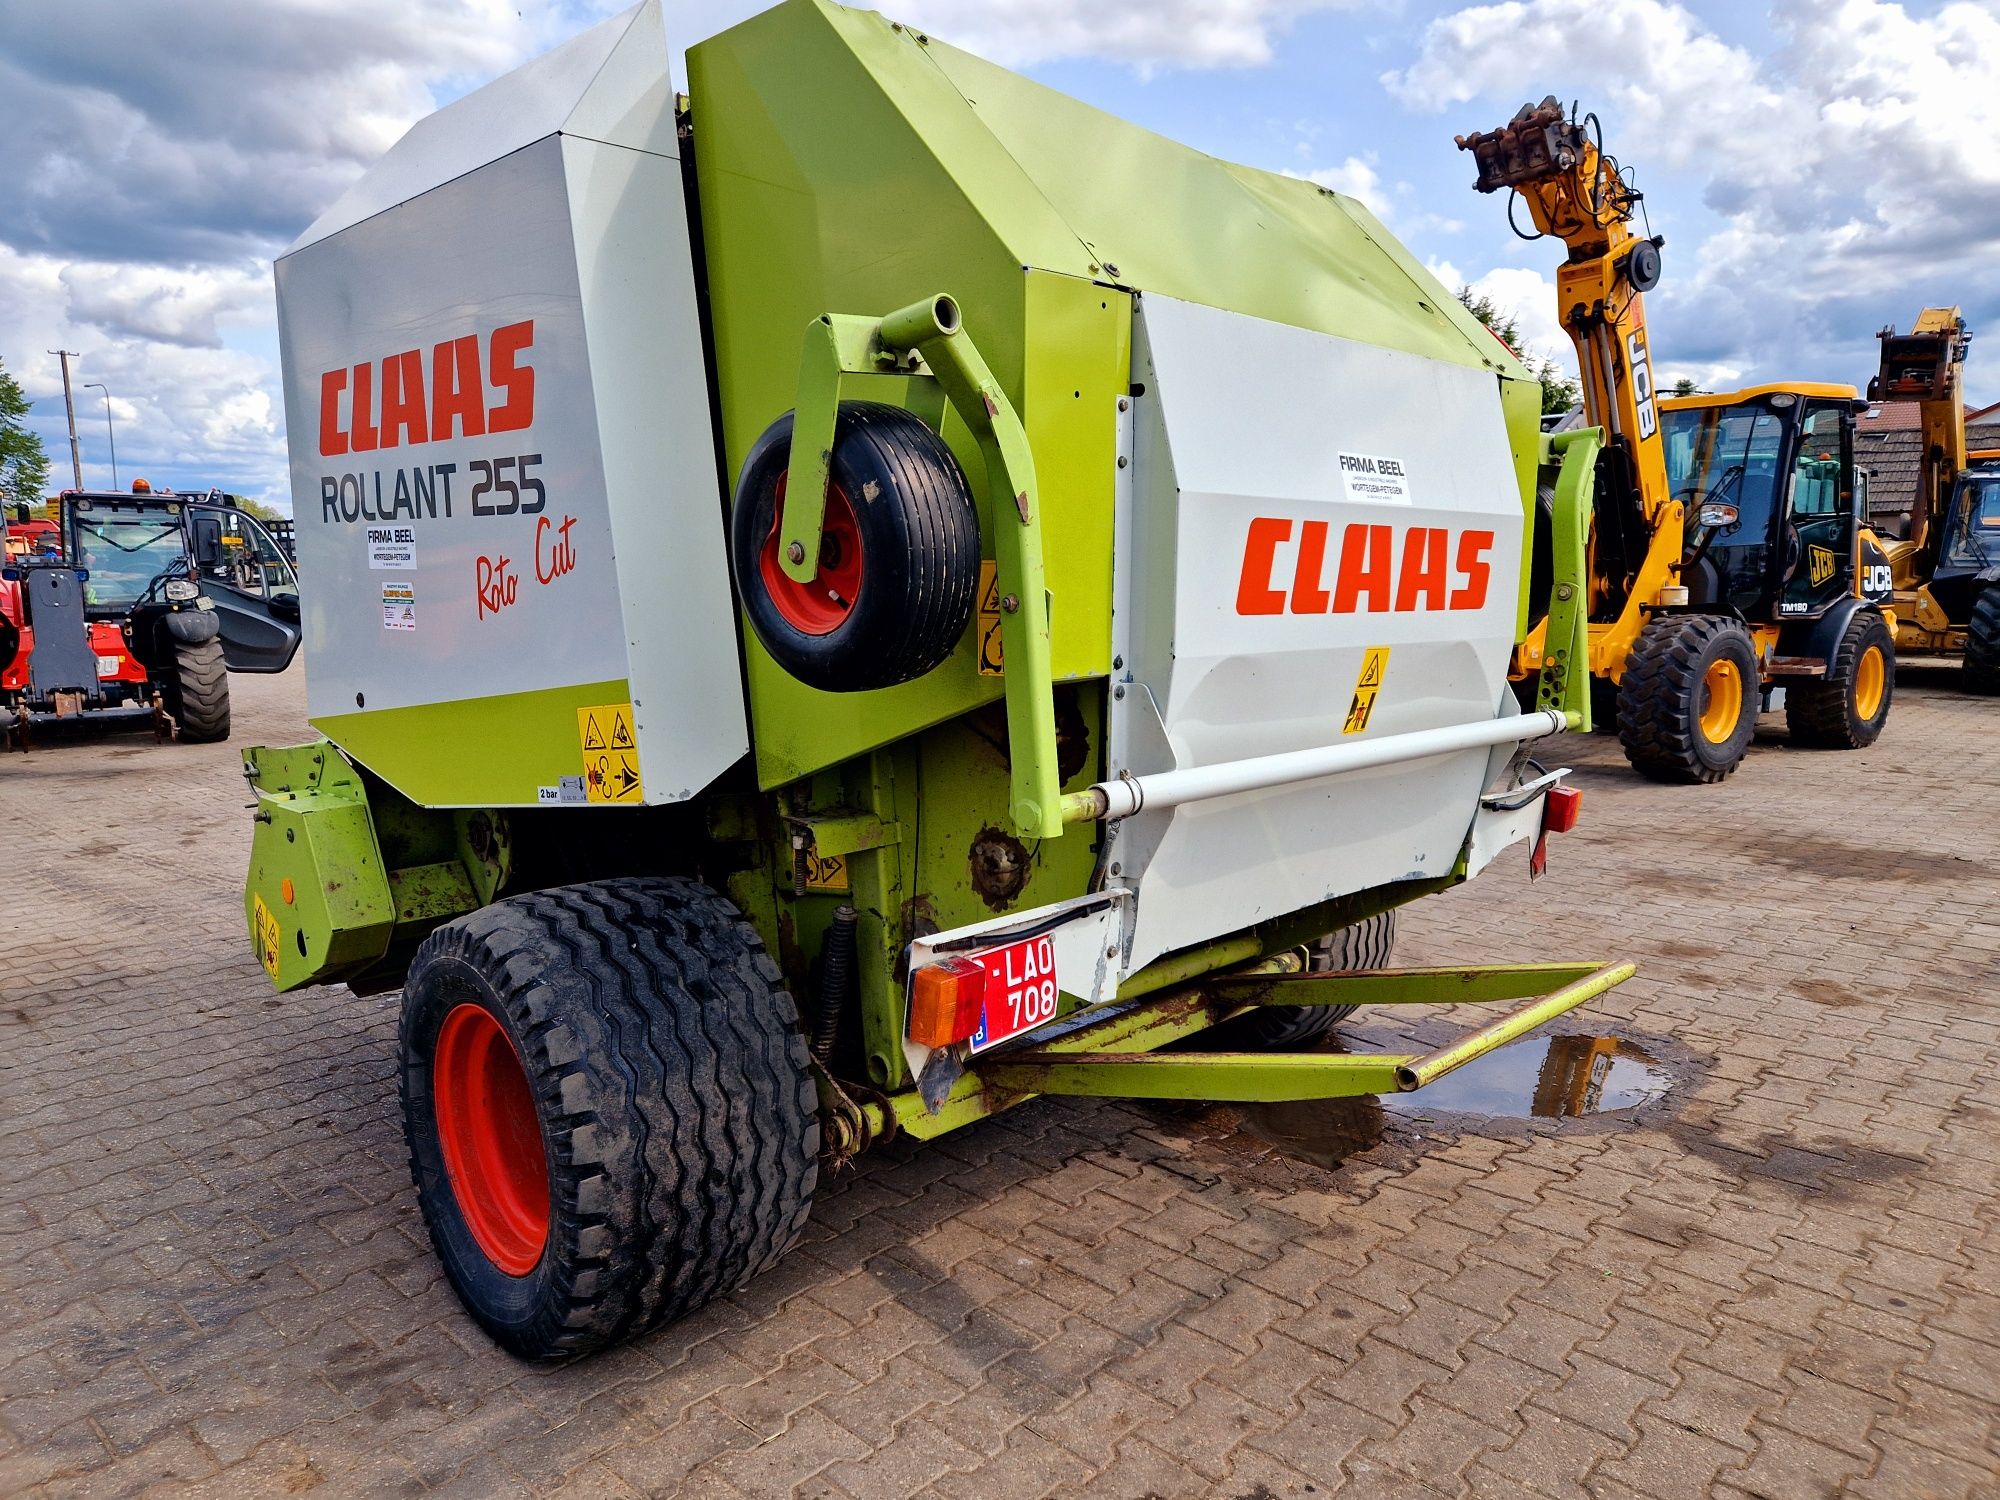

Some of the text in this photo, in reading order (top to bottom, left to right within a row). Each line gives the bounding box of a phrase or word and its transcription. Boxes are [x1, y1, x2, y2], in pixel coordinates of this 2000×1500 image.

[319, 320, 534, 457] CLAAS
[1628, 334, 1656, 440] JCB
[321, 454, 546, 523] ROLLANT 255
[1339, 455, 1405, 477] FIRMA BEEL
[368, 529, 415, 543] FIRMA BEEL
[476, 515, 577, 620] Roto Cut
[1236, 517, 1494, 615] CLAAS
[1812, 549, 1834, 582] JCB
[1863, 565, 1893, 592] JCB
[540, 788, 546, 799] 2
[546, 788, 558, 799] bar
[1007, 980, 1055, 1030] 708
